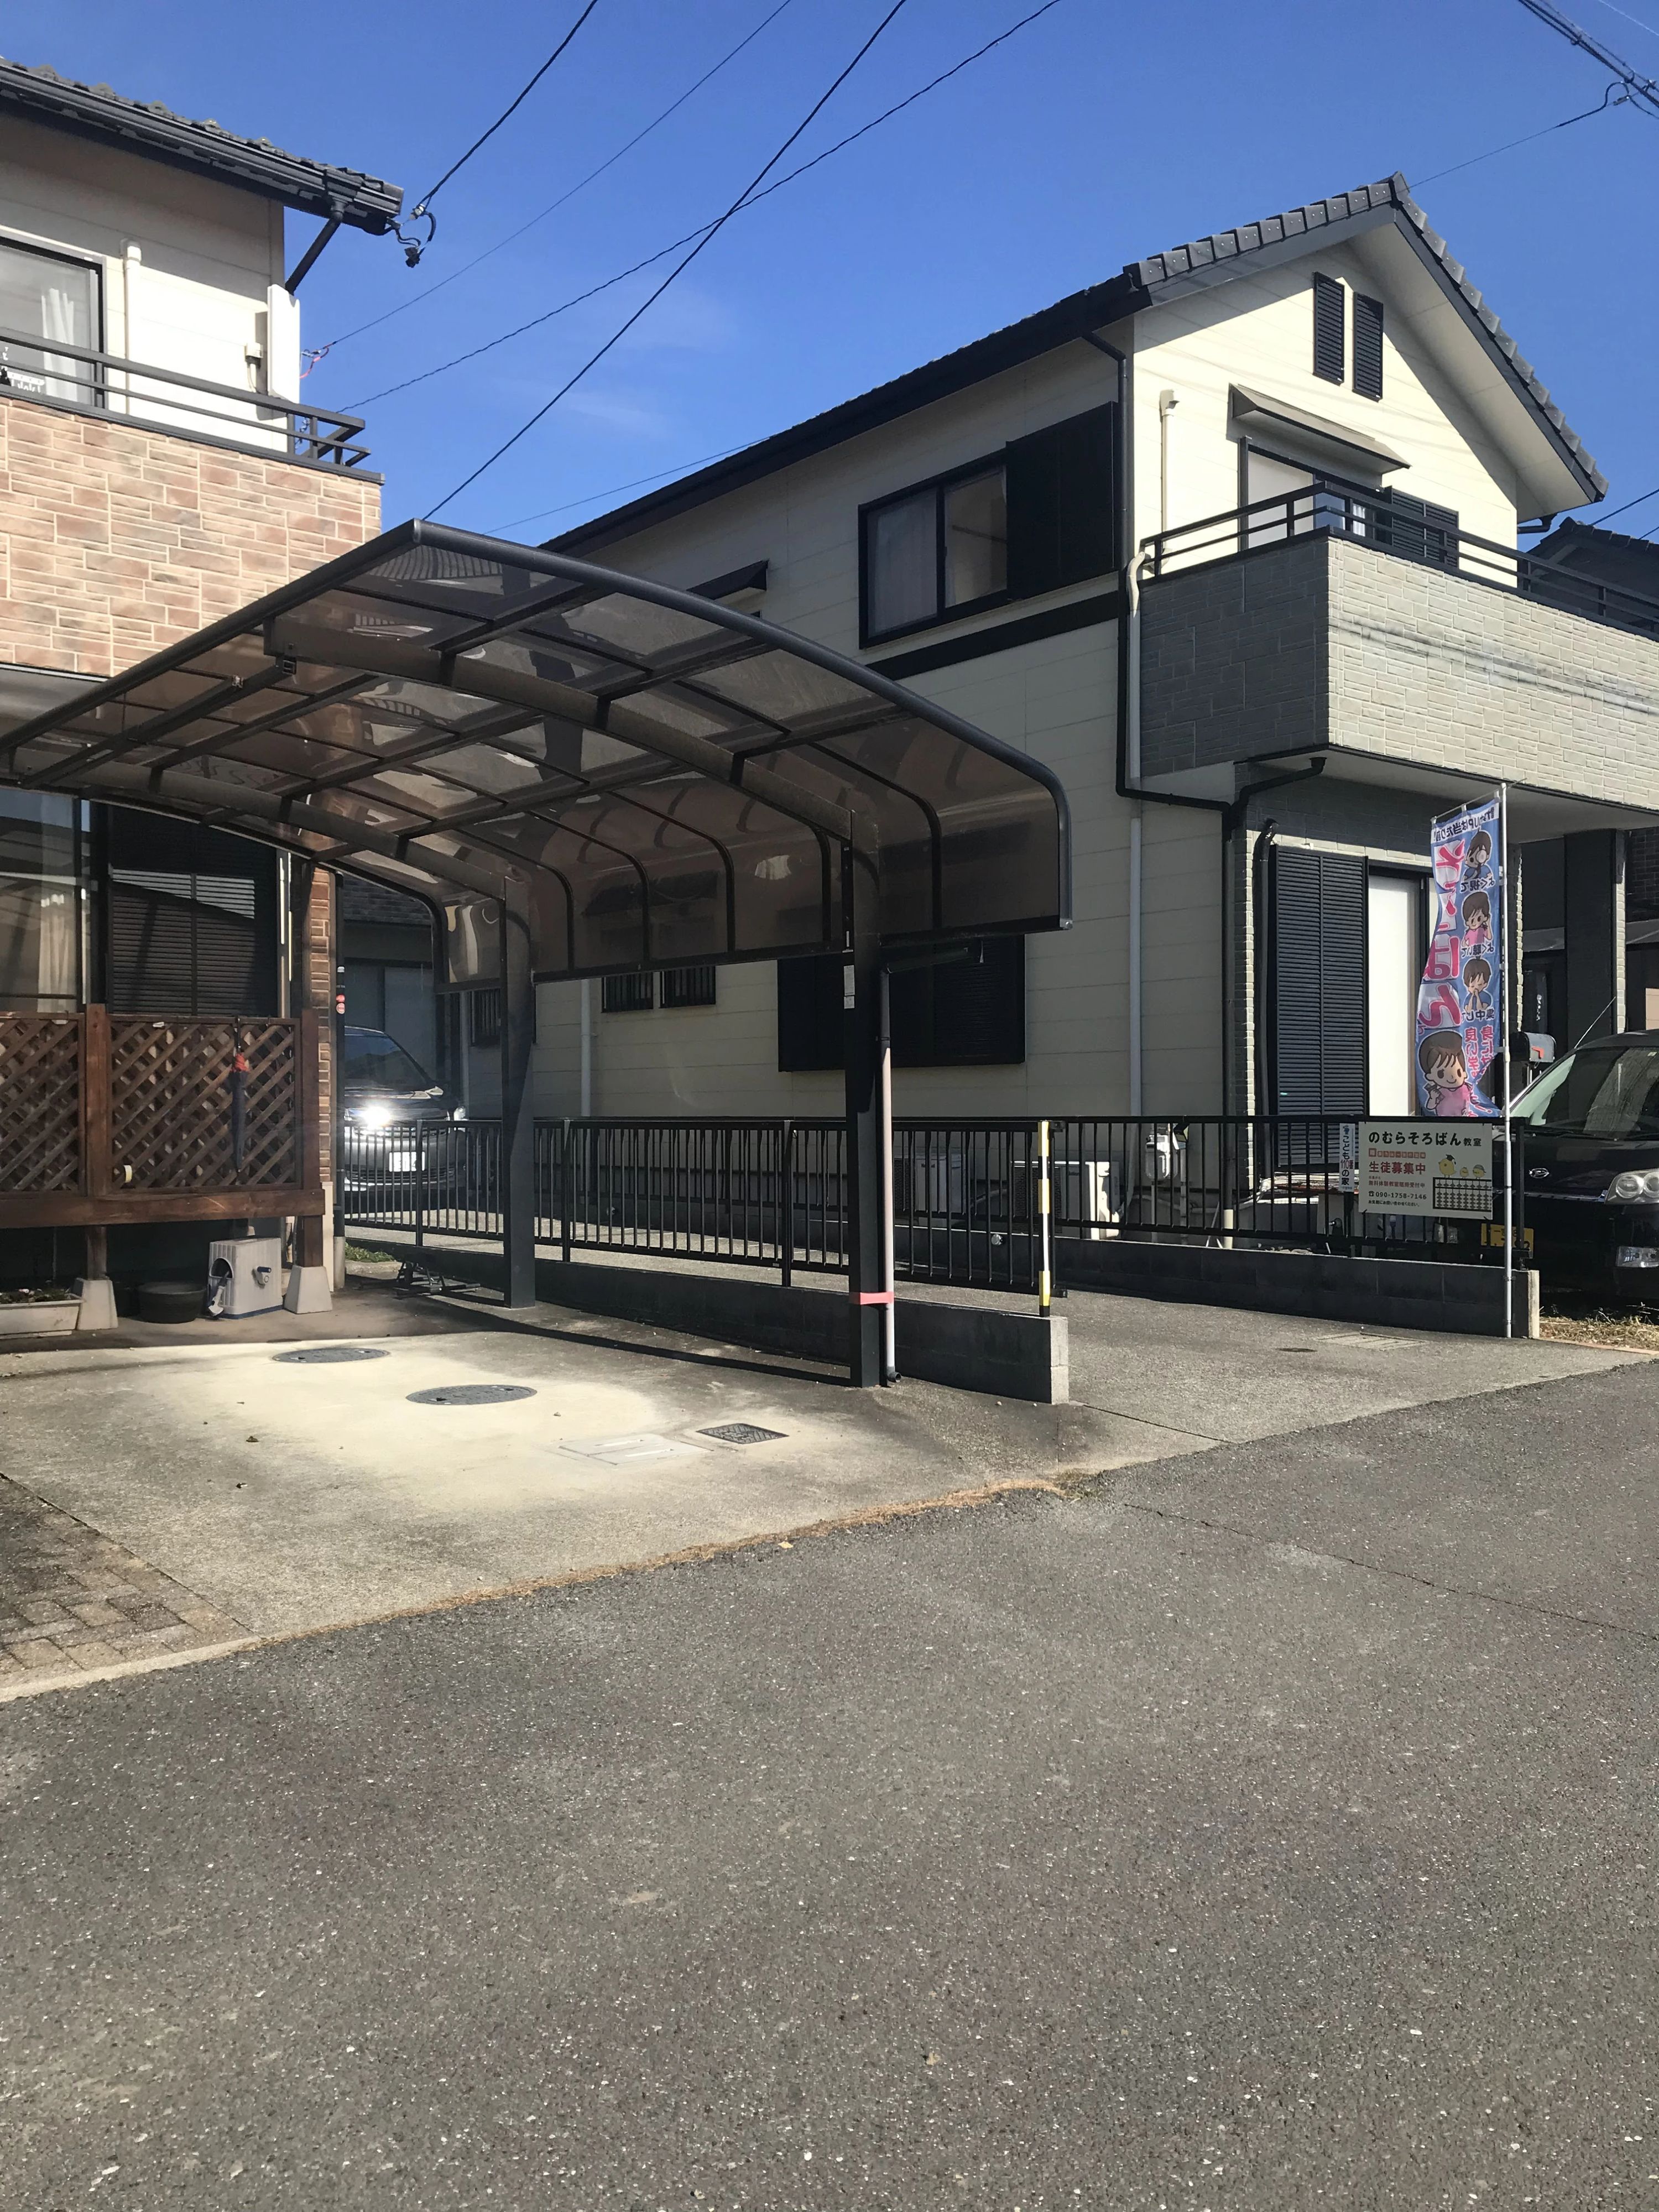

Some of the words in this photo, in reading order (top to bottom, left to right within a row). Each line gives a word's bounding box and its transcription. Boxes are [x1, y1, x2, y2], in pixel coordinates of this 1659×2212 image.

[1369, 1131, 1482, 1147] のむらそろばん教室
[1369, 1162, 1426, 1175] 生徒募集中
